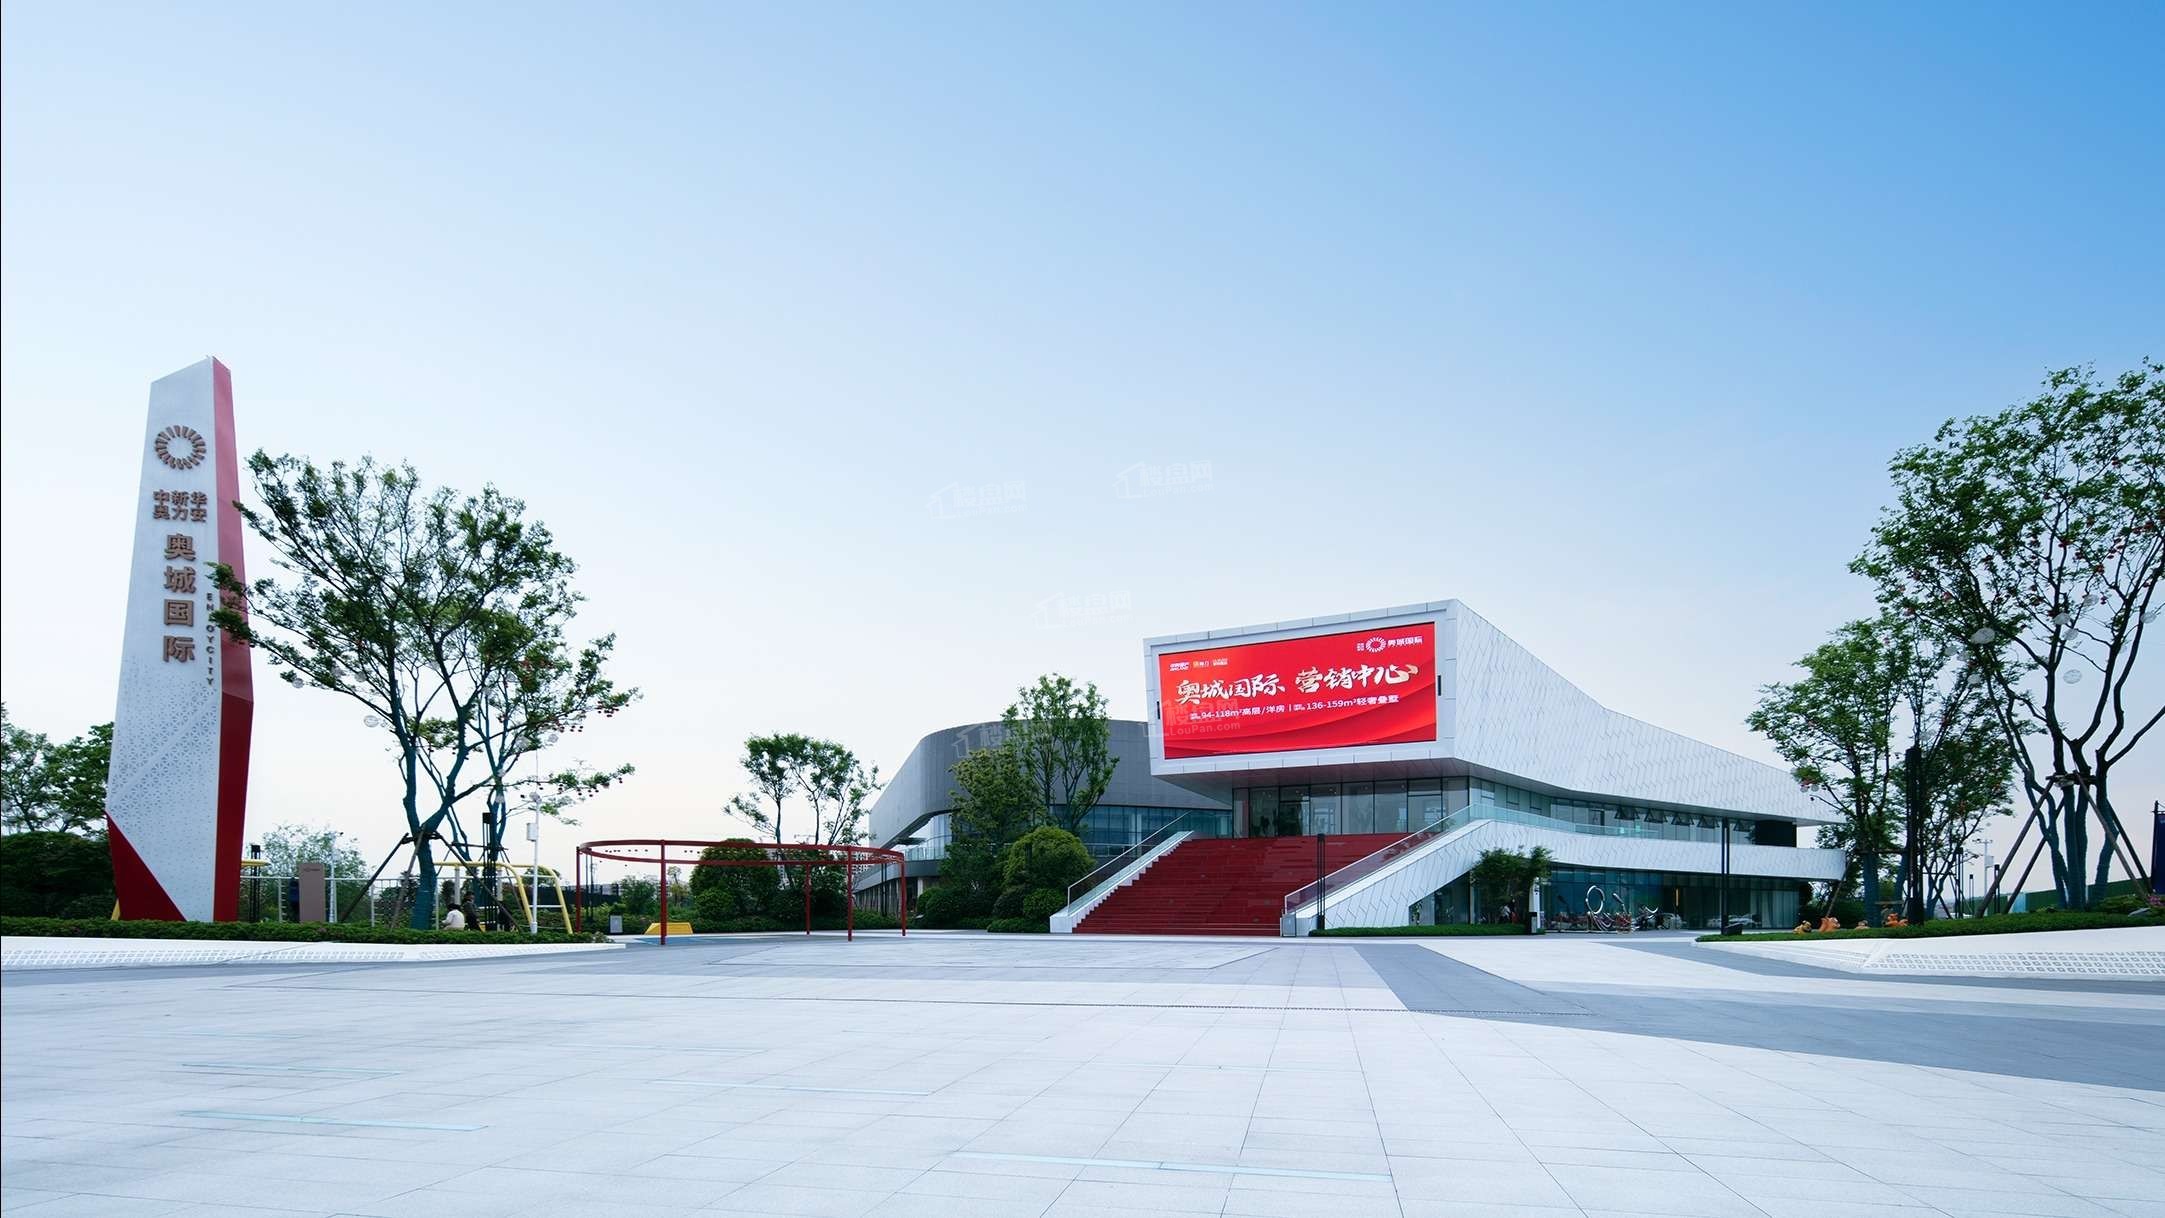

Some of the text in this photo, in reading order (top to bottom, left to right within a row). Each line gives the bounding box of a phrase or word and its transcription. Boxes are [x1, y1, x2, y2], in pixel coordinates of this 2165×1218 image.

[163, 533, 197, 663] 奥城国际
[206, 592, 215, 686] ENOYCITY
[1175, 664, 1419, 705] 奥城国际 营销中心
